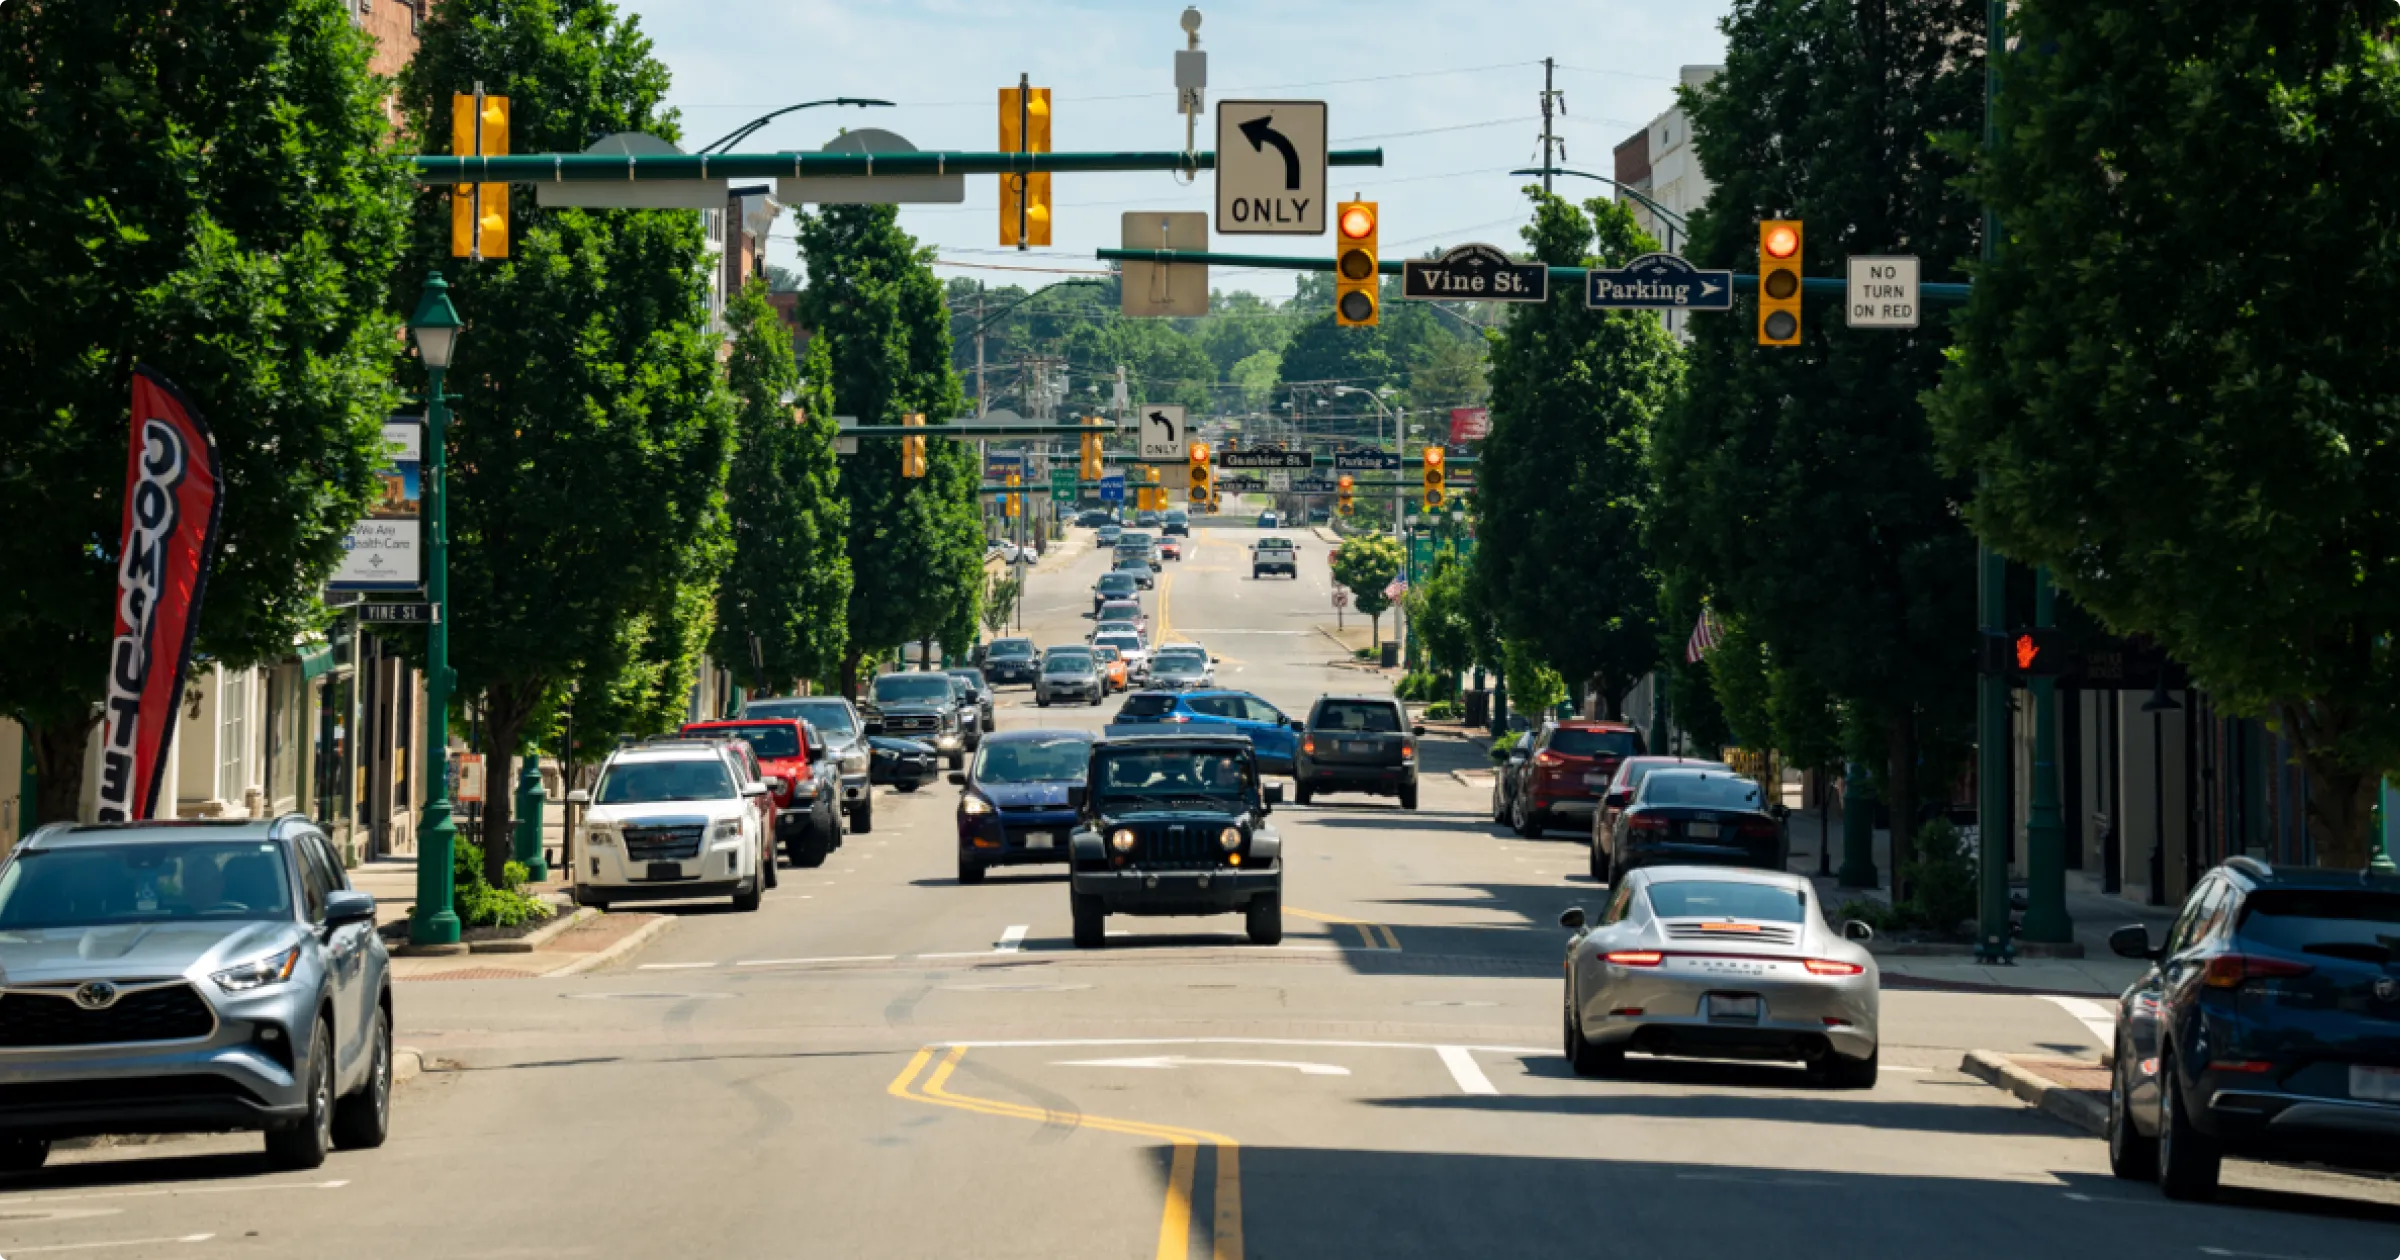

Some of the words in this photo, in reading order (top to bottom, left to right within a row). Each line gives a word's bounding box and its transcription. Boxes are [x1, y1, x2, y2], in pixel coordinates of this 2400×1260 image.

[1232, 197, 1310, 223] ONLY
[1870, 266, 1896, 279] NO
[1419, 269, 1485, 292] Vine
[1494, 271, 1530, 293] St.
[1596, 278, 1690, 305] Parking
[1863, 284, 1905, 298] TURN
[1853, 304, 1874, 318] ON
[1883, 304, 1913, 318] RED
[1145, 444, 1179, 454] ONLY
[1227, 454, 1283, 466] Gambier
[1339, 456, 1383, 468] Parking
[368, 606, 396, 619] VINE
